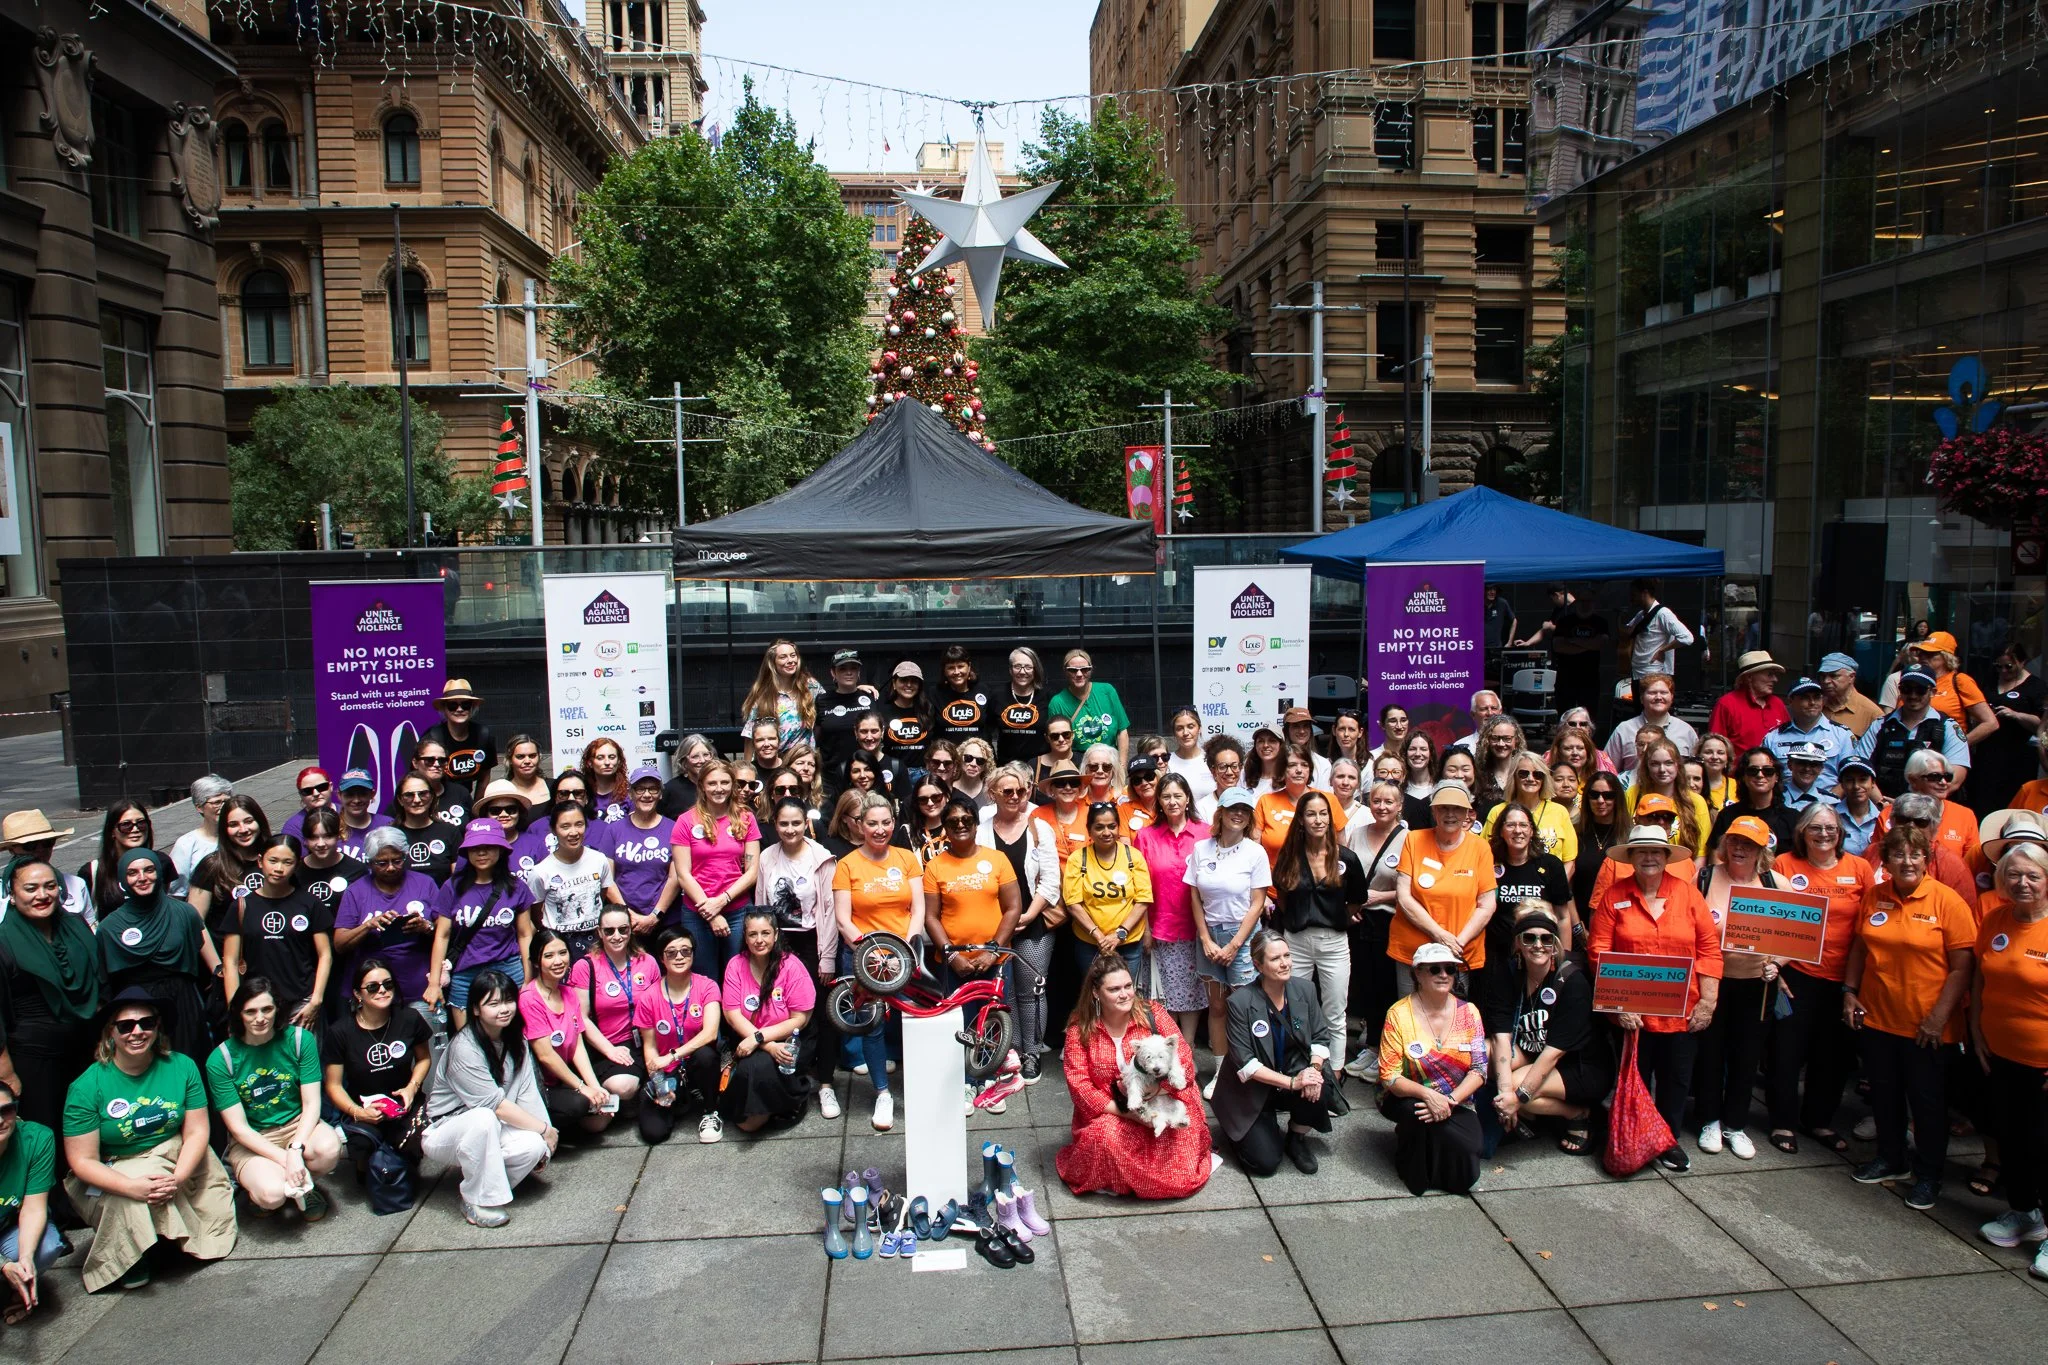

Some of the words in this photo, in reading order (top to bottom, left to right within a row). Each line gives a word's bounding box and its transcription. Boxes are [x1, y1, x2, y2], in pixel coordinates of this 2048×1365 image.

[698, 550, 747, 562] Marquee
[366, 610, 392, 618] UNITE
[1393, 629, 1414, 639] NO
[1420, 628, 1459, 638] MORE
[562, 642, 581, 654] DV
[1208, 637, 1227, 648] DV
[1379, 642, 1424, 652] EMPTY
[1429, 640, 1474, 651] SHOES
[344, 648, 367, 658] NO
[374, 646, 418, 657] MORE
[327, 661, 379, 673] EMPTY
[385, 658, 434, 670] SHOES
[1408, 655, 1445, 665] VIGIL
[361, 673, 403, 684] VIGIL
[1381, 671, 1406, 680] Stand
[1408, 671, 1426, 679] with
[1440, 670, 1469, 680] against
[1389, 682, 1427, 690] domestic
[1430, 681, 1464, 689] violence
[331, 691, 358, 700] Stand
[362, 690, 381, 699] with
[397, 688, 430, 698] against
[340, 701, 383, 711] domestic
[386, 699, 424, 708] violence
[616, 841, 669, 863] 4Voices
[573, 875, 592, 885] LEGAL
[1731, 900, 1765, 914] Zonta
[1770, 906, 1796, 919] Says
[1801, 910, 1822, 922] NO
[1726, 932, 1760, 941] BEACHES
[1727, 924, 1751, 932] ZONTA
[1774, 930, 1817, 942] NORTHERN
[1600, 967, 1632, 977] Zonta
[1637, 970, 1662, 980] Says
[1667, 971, 1686, 980] NO
